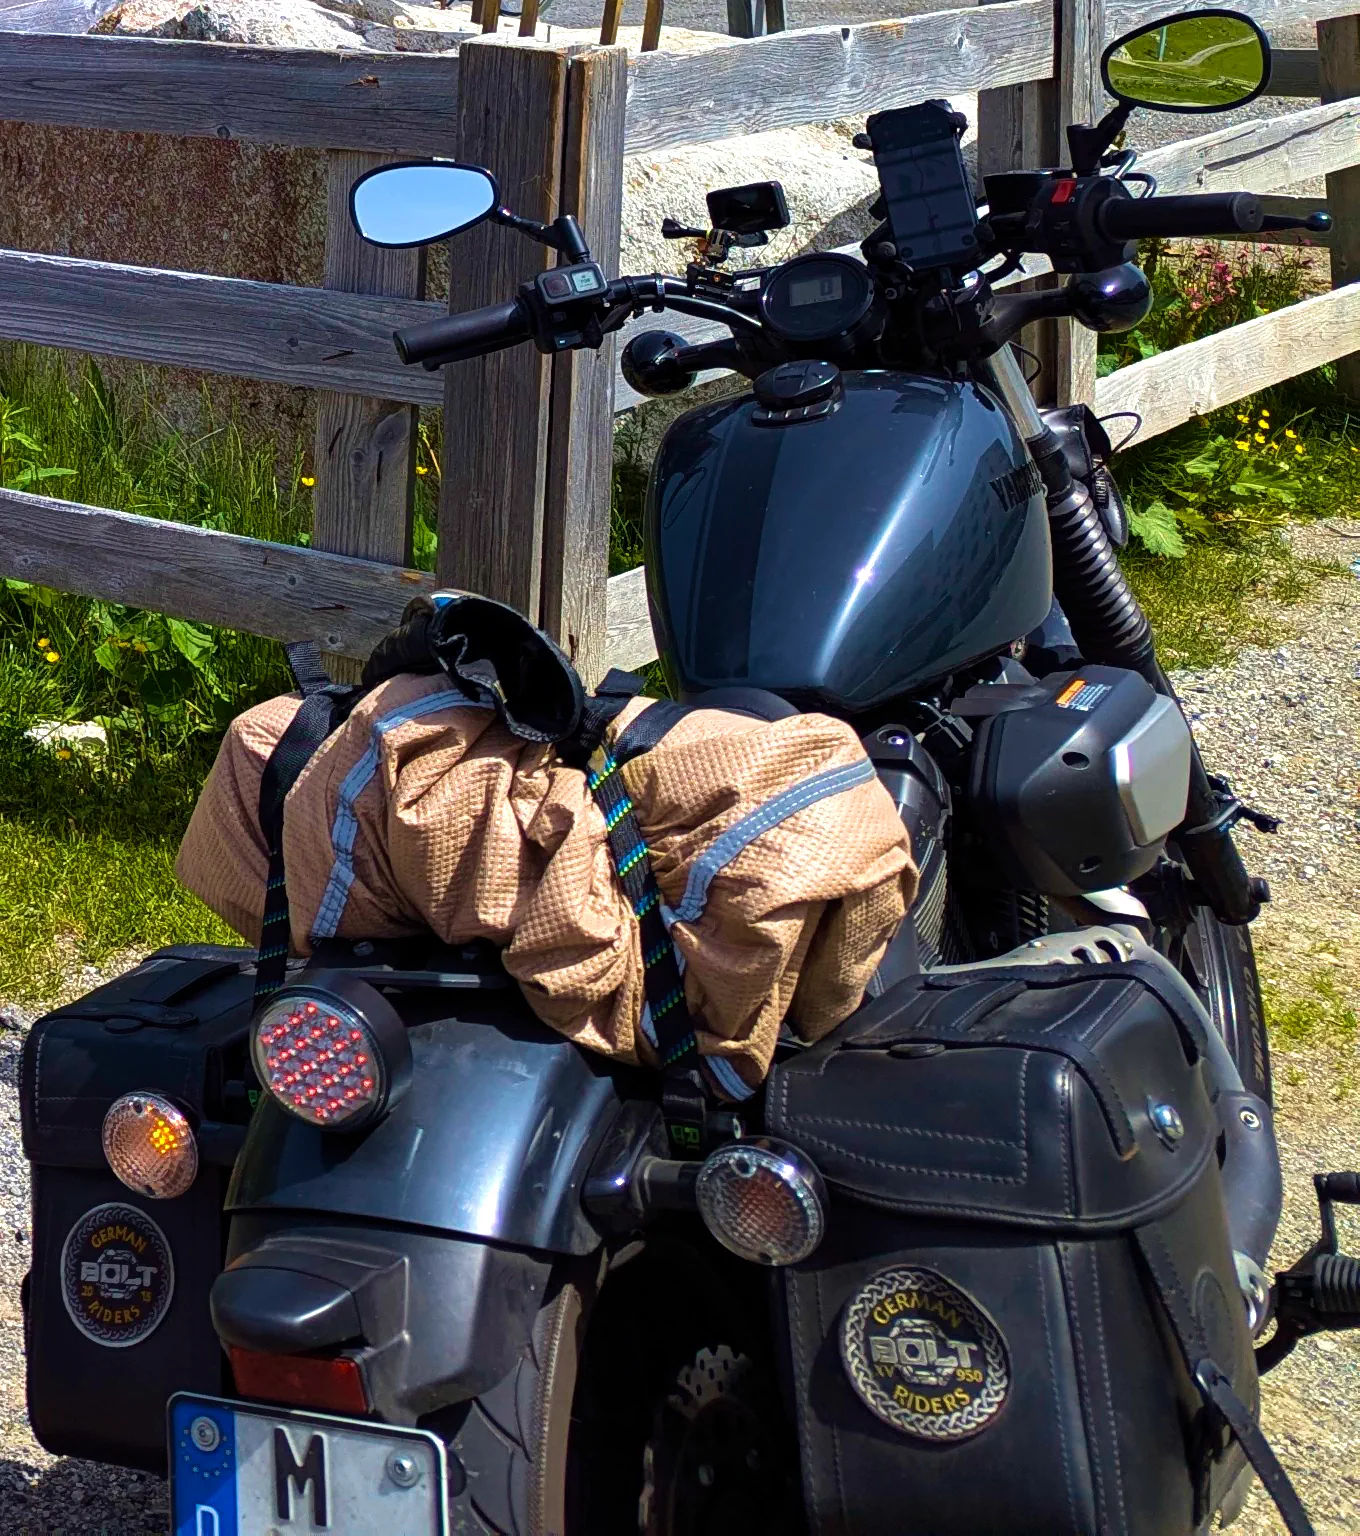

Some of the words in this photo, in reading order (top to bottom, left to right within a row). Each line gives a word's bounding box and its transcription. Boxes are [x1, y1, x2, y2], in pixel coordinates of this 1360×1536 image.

[91, 1225, 148, 1253] GERMAN
[80, 1261, 158, 1288] BOLT
[88, 1300, 142, 1324] RIDERS
[872, 1291, 962, 1329] GERMAN
[869, 1335, 978, 1368] BOLT
[956, 1366, 984, 1384] 950
[892, 1384, 970, 1415] RIDERS
[273, 1424, 330, 1528] M
